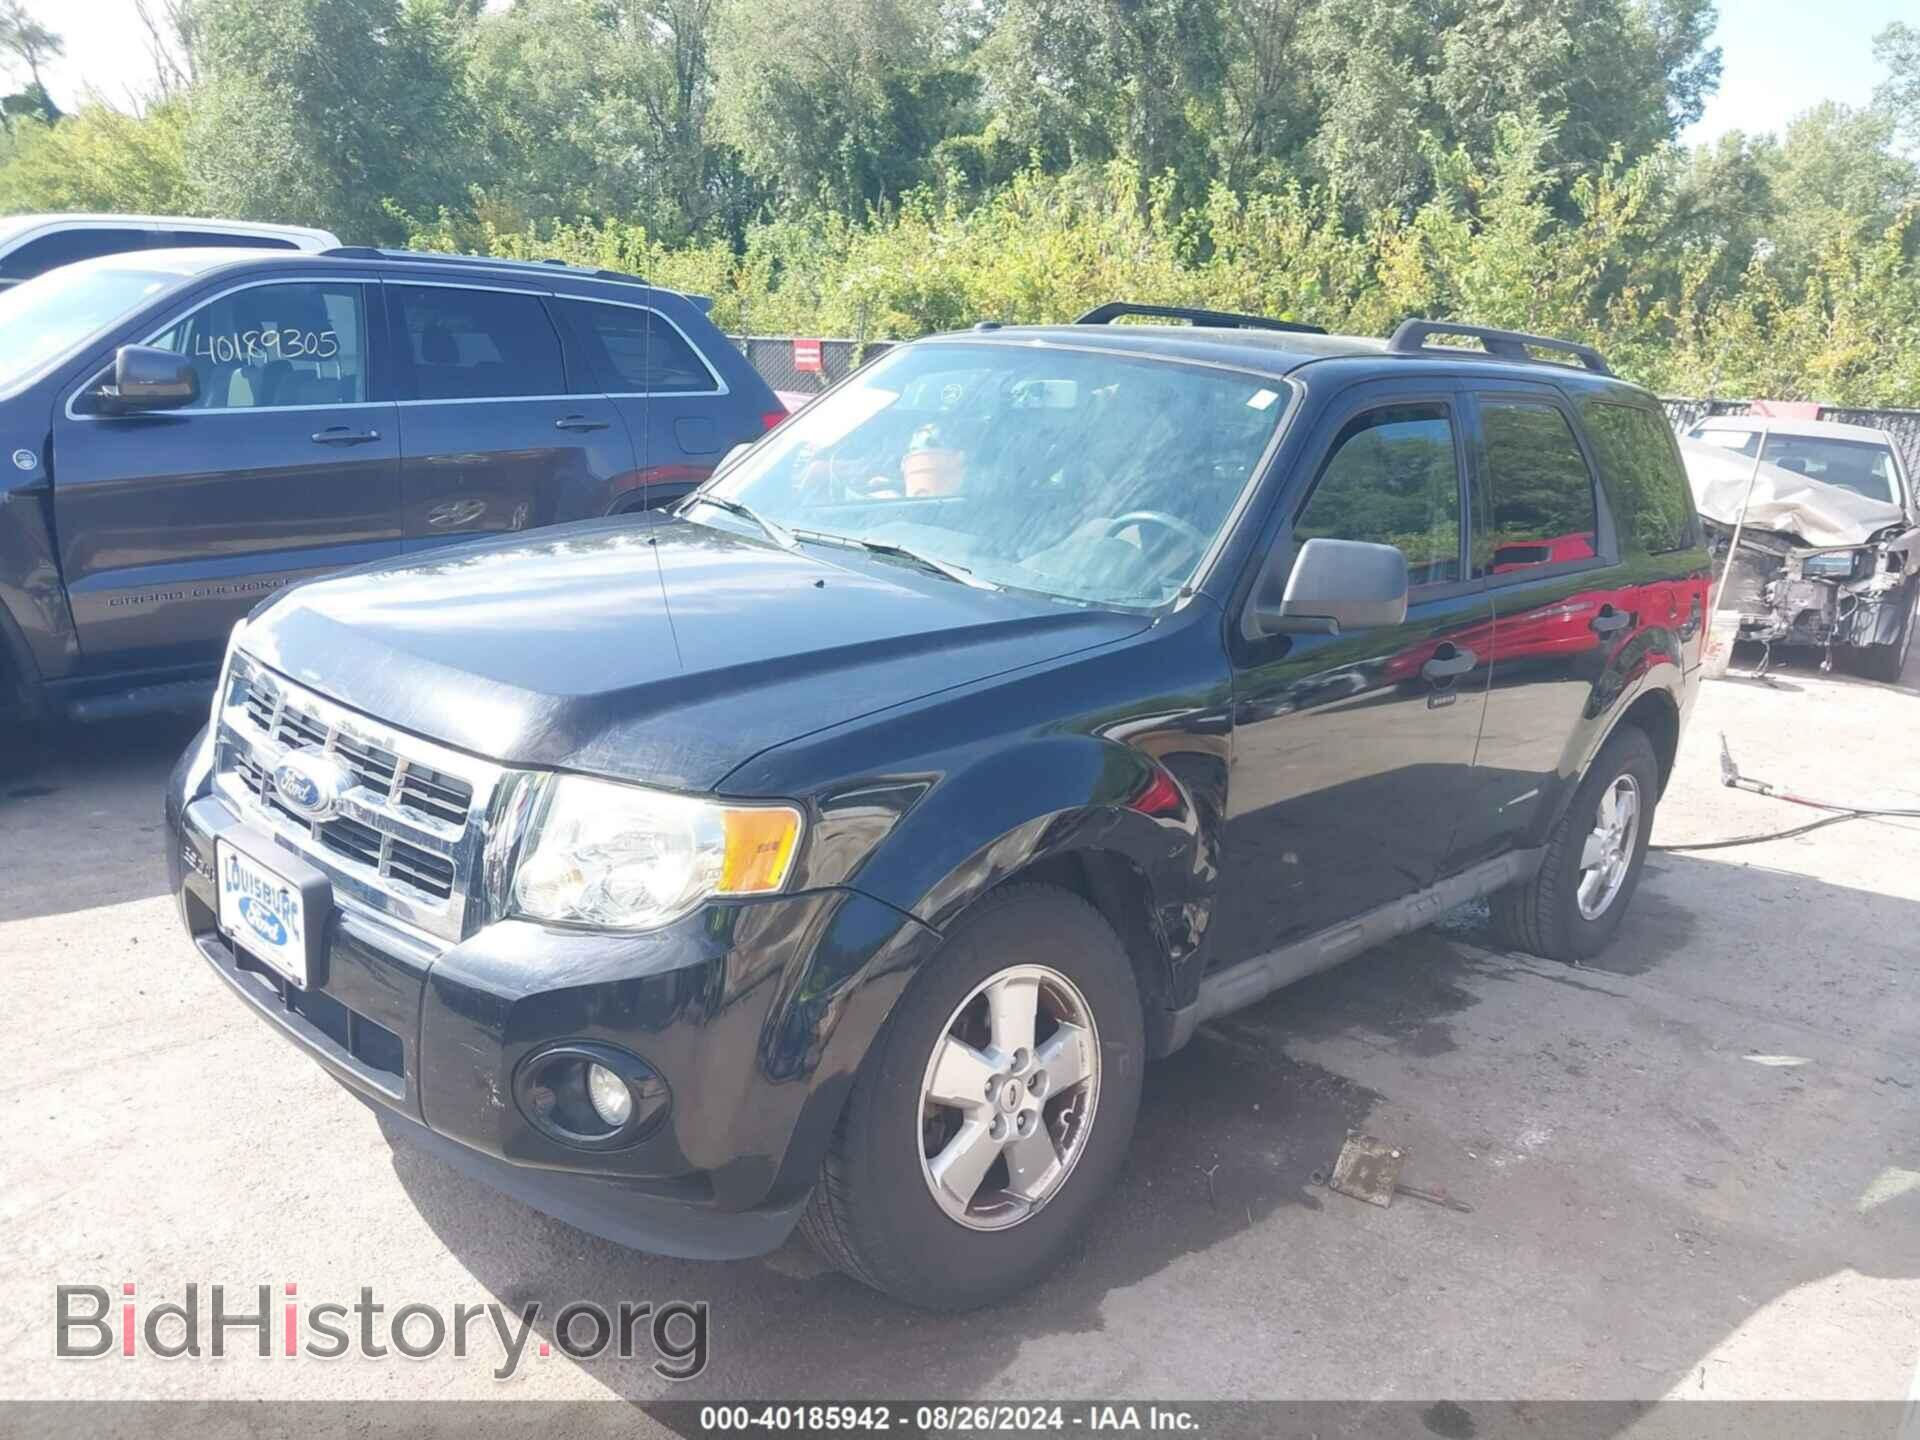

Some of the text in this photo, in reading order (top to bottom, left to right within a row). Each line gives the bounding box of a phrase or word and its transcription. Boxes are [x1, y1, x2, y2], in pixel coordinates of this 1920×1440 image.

[196, 329, 337, 365] 40189305
[280, 770, 312, 801] Ford
[246, 901, 280, 941] Ford
